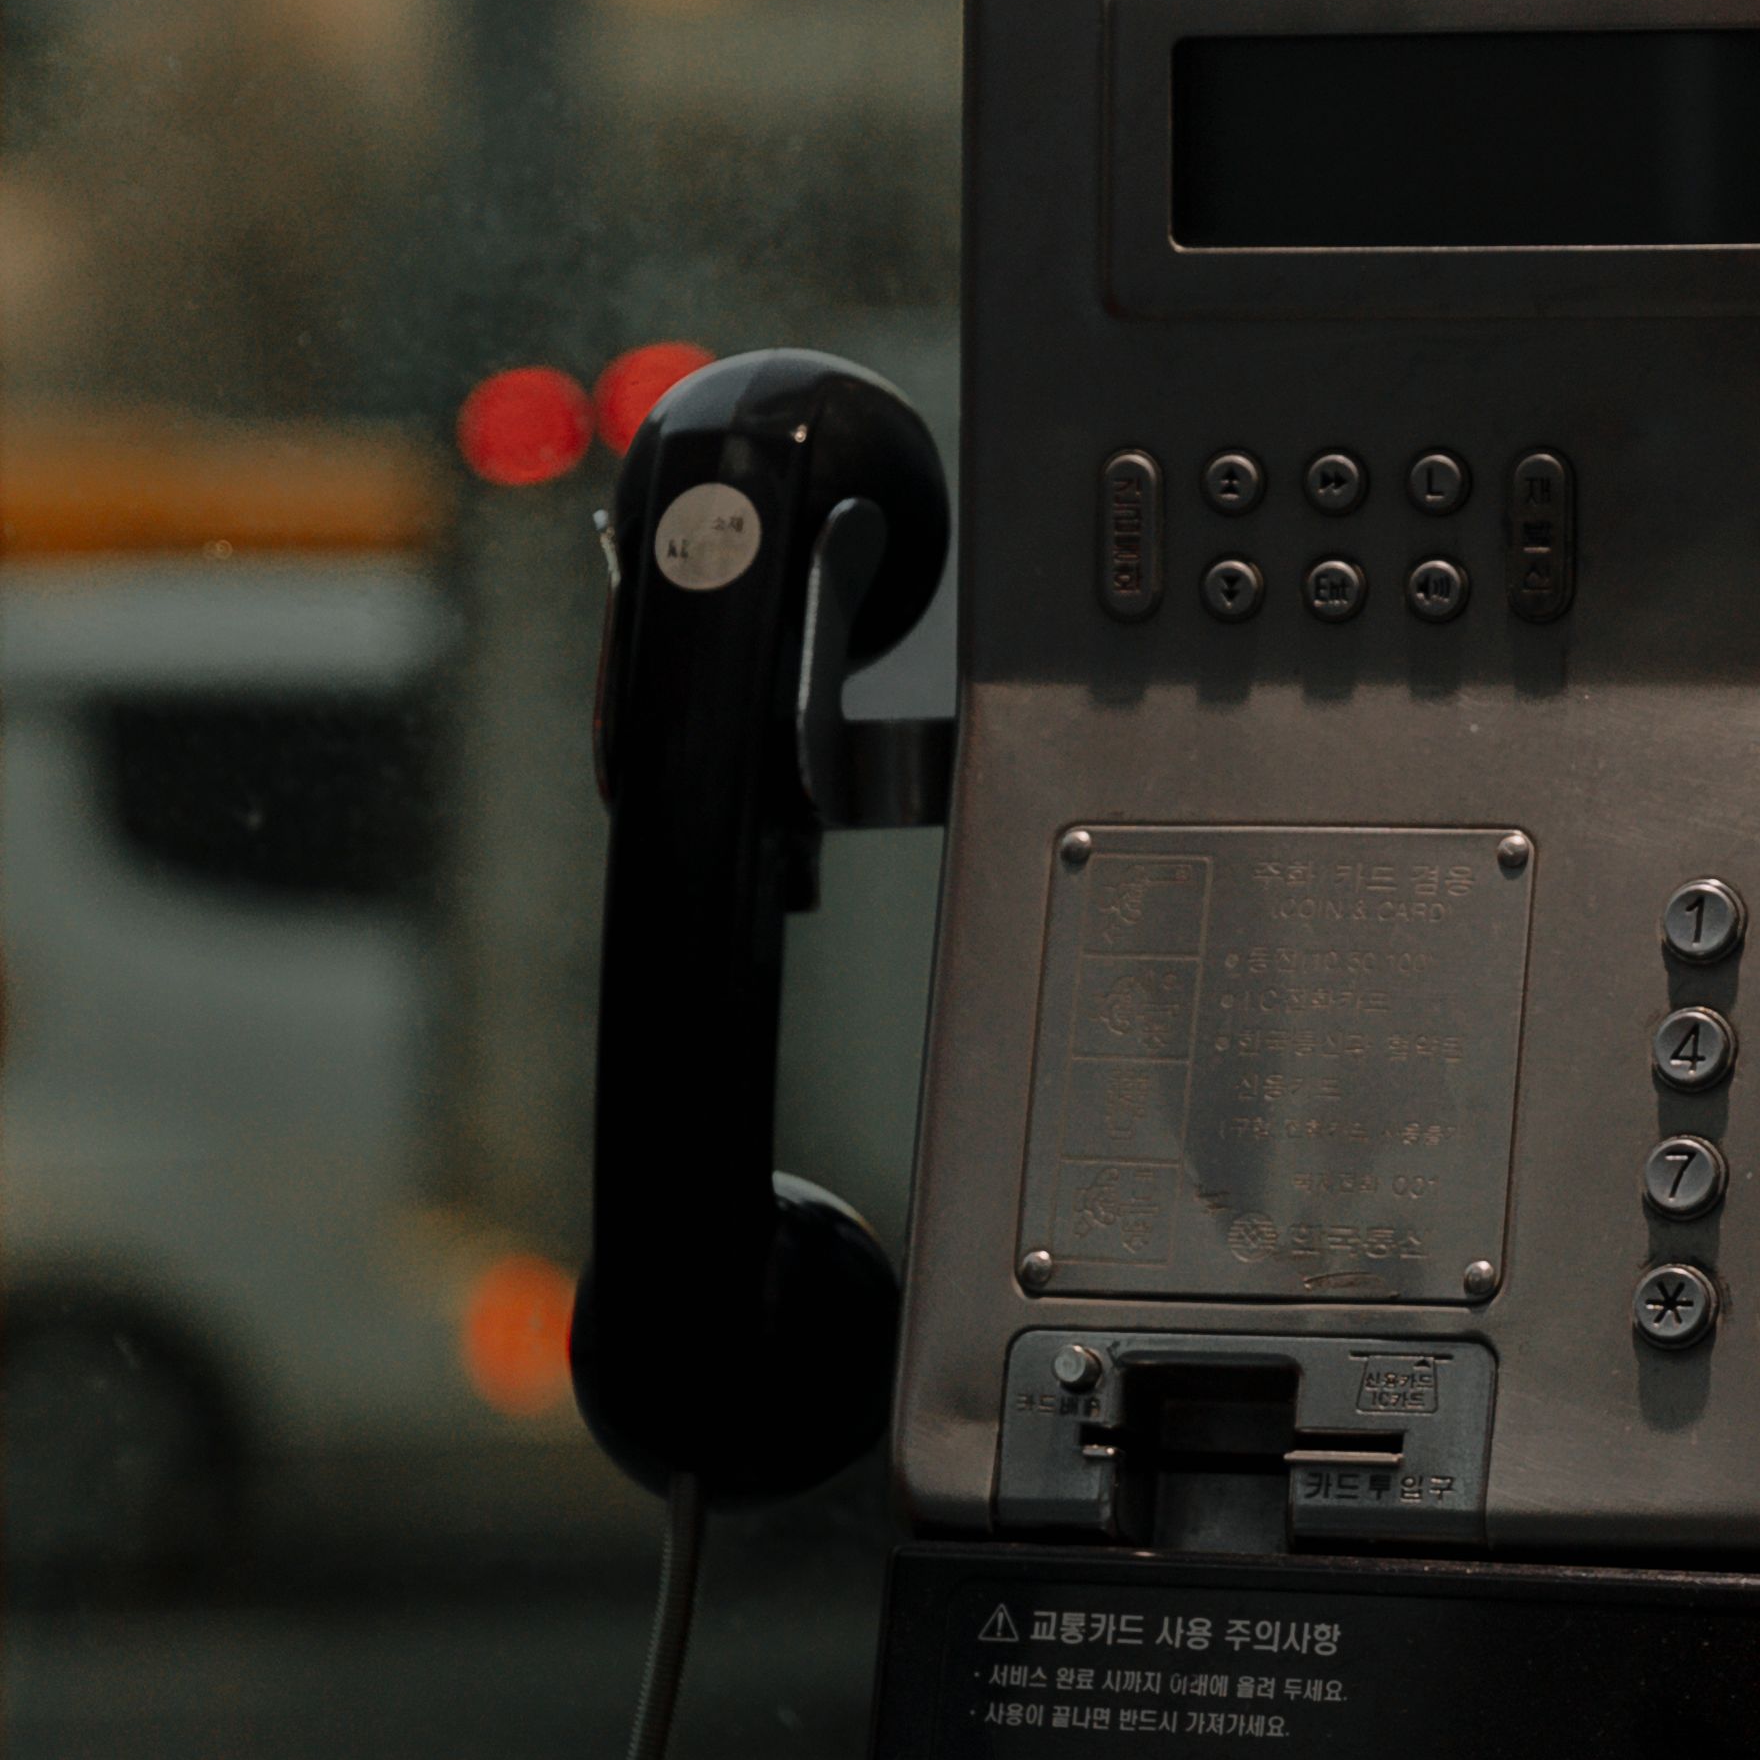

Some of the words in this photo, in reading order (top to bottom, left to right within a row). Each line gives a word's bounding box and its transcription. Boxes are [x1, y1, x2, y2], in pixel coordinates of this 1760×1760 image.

[1426, 468, 1443, 496] L
[1315, 574, 1349, 601] Ent
[1334, 863, 1398, 893] 카드
[1685, 896, 1705, 944] 1
[1671, 1022, 1705, 1072] 4
[1665, 1151, 1696, 1199] 7
[1305, 1472, 1457, 1503] 카드투입구
[1030, 1610, 1144, 1646] 교통카드
[1155, 1615, 1212, 1651] 사용
[1224, 1618, 1342, 1657] 주의사항
[989, 1664, 1048, 1689] 서비스
[1055, 1668, 1095, 1692] 완료
[1101, 1669, 1161, 1695] 시까지
[1170, 1672, 1229, 1697] 아래에
[1236, 1675, 1275, 1699] 올려
[1283, 1677, 1349, 1703] 두세요.
[985, 1701, 1044, 1727] 사용이
[1051, 1705, 1110, 1731] 끝나면
[1119, 1708, 1178, 1734] 반드시
[1186, 1711, 1290, 1738] 가져가세요.
